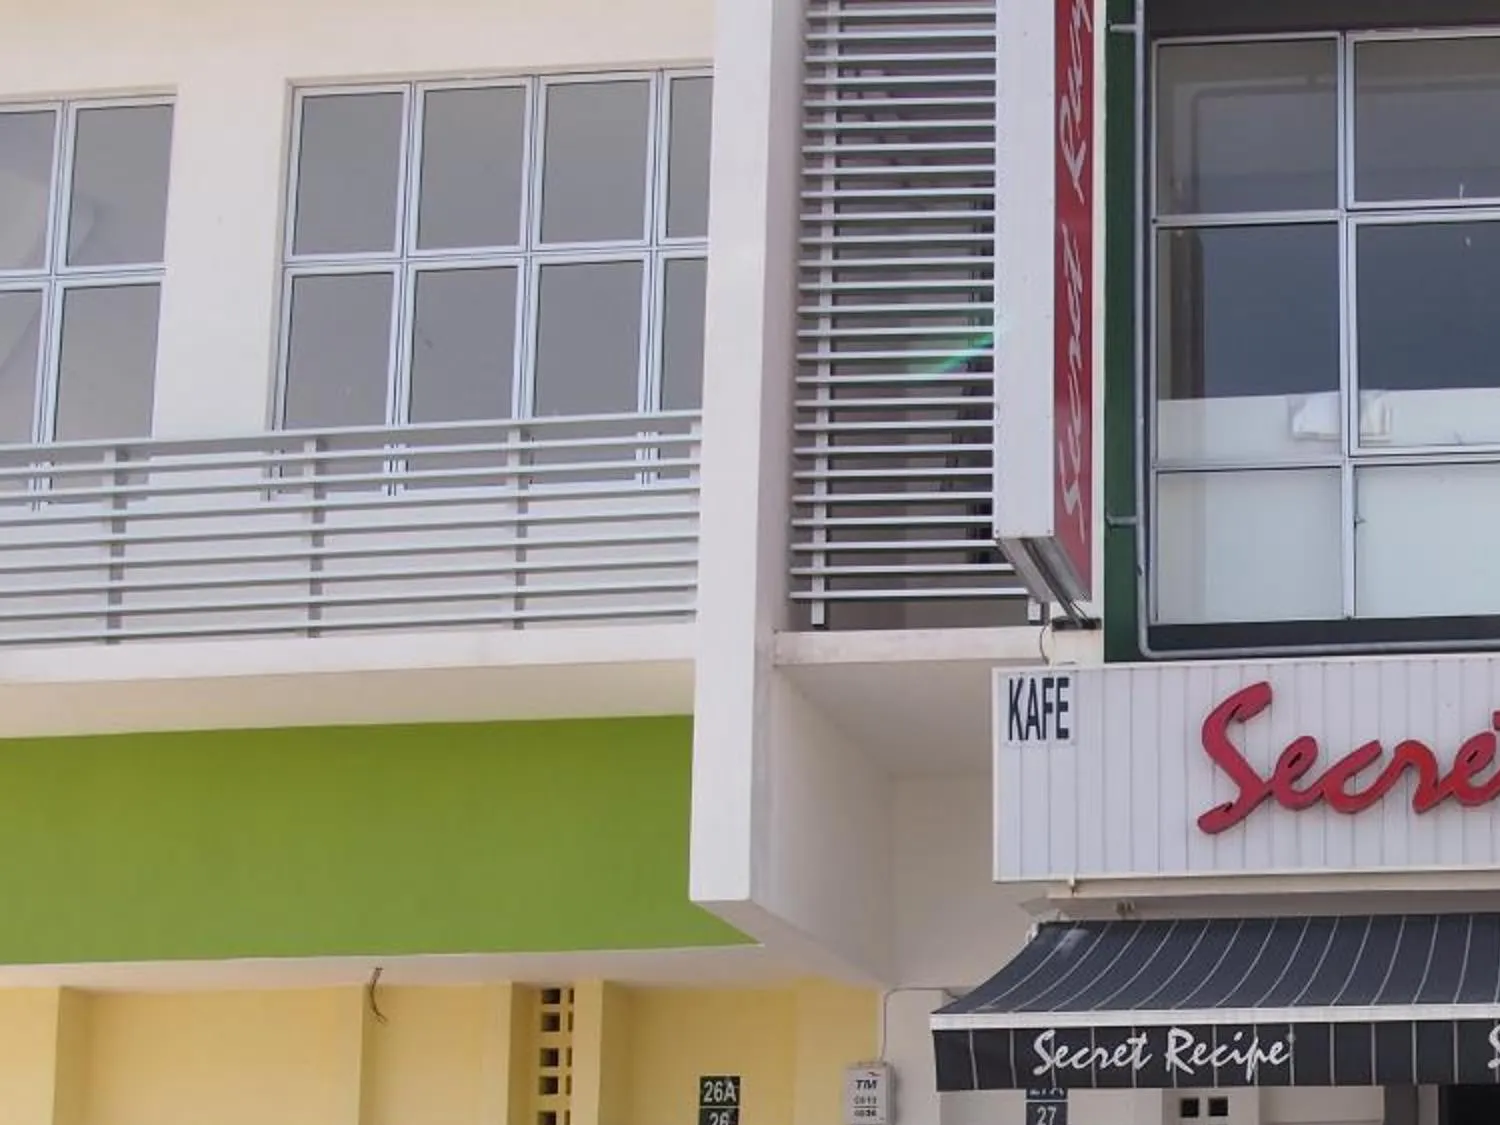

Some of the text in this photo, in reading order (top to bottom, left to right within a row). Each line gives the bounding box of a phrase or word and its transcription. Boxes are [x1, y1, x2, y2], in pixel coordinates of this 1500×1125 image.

[1059, 222, 1083, 545] Secret
[1007, 676, 1070, 741] KAFE
[1033, 1026, 1292, 1082] Secret Recipe
[702, 1079, 737, 1104] 26A
[855, 1079, 877, 1089] TM
